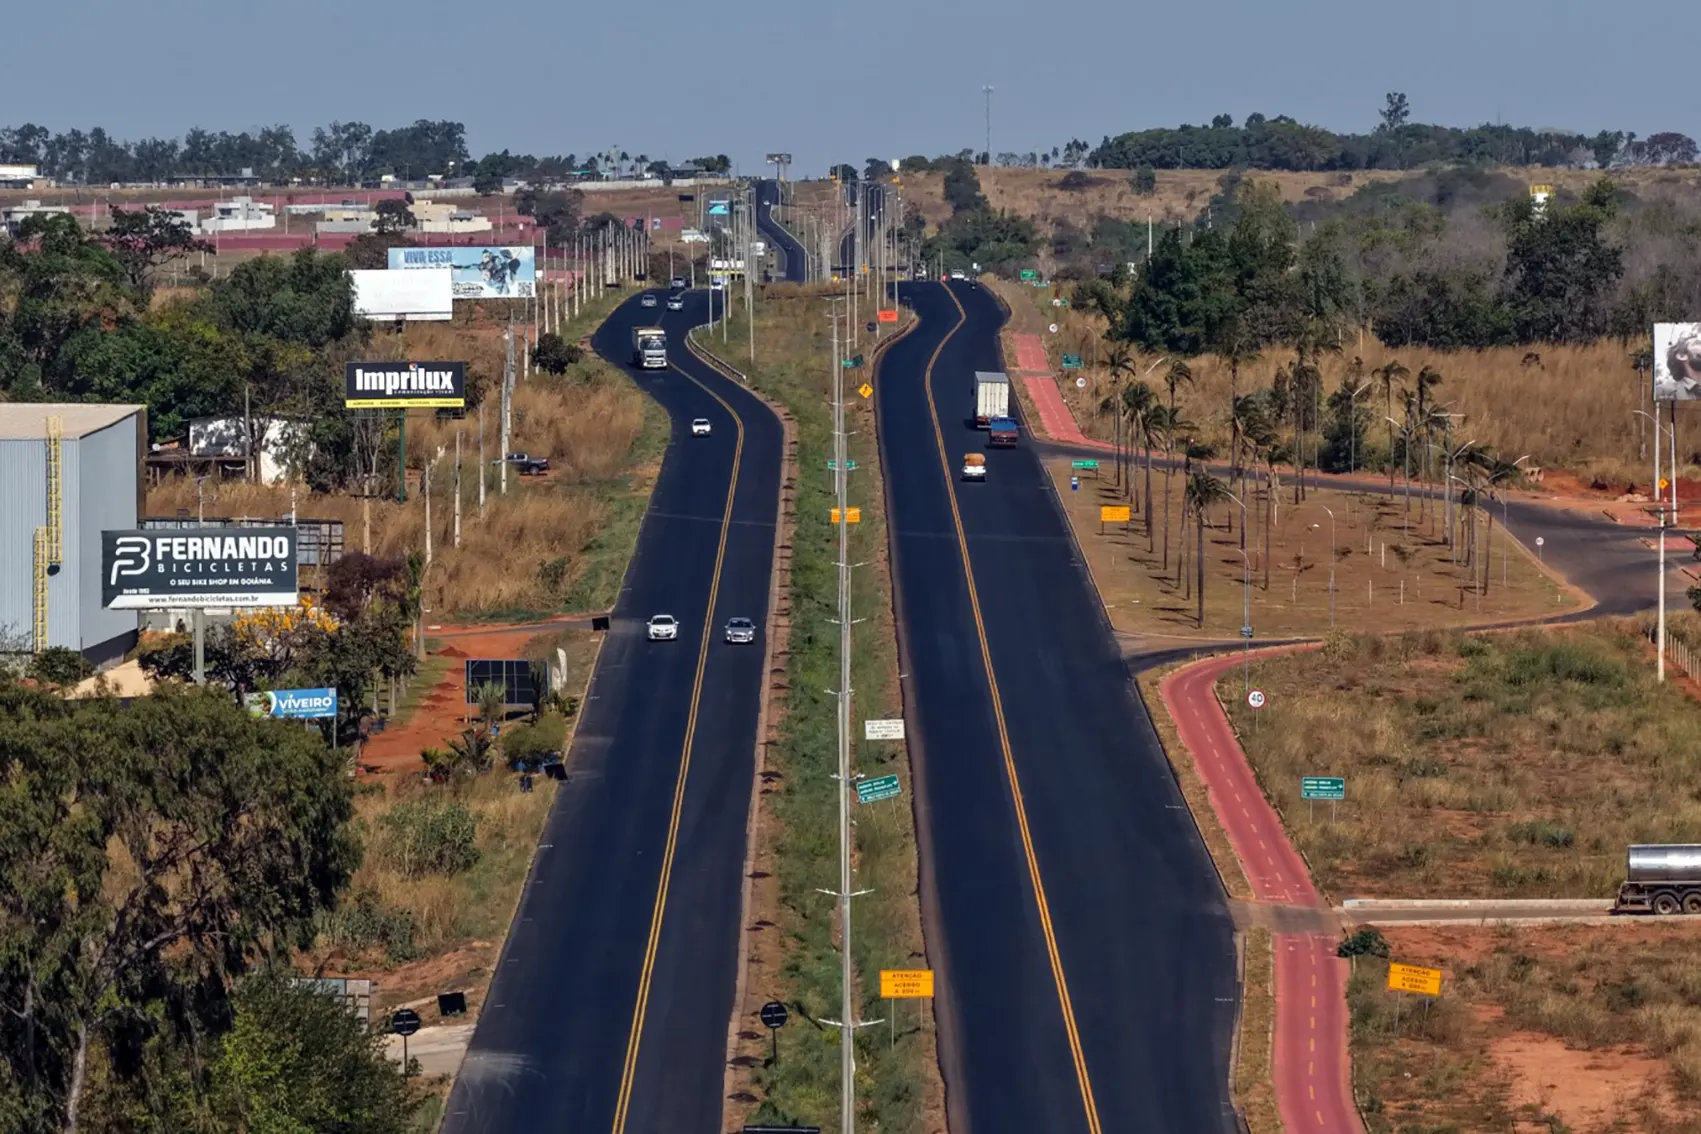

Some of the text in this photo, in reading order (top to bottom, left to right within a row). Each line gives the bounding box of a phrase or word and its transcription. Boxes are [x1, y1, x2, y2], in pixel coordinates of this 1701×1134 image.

[404, 250, 452, 263] VIVA ESSA
[355, 363, 454, 395] Imprilux
[156, 536, 289, 560] FERNANDO
[157, 561, 288, 573] BICICLETAS
[169, 578, 177, 586] O
[178, 578, 191, 586] SEU
[192, 578, 208, 586] BIKE
[209, 578, 228, 586] SHOP
[229, 578, 240, 586] EM
[148, 594, 259, 603] www.fernandobicicletas.com.br
[1251, 693, 1263, 703] 40
